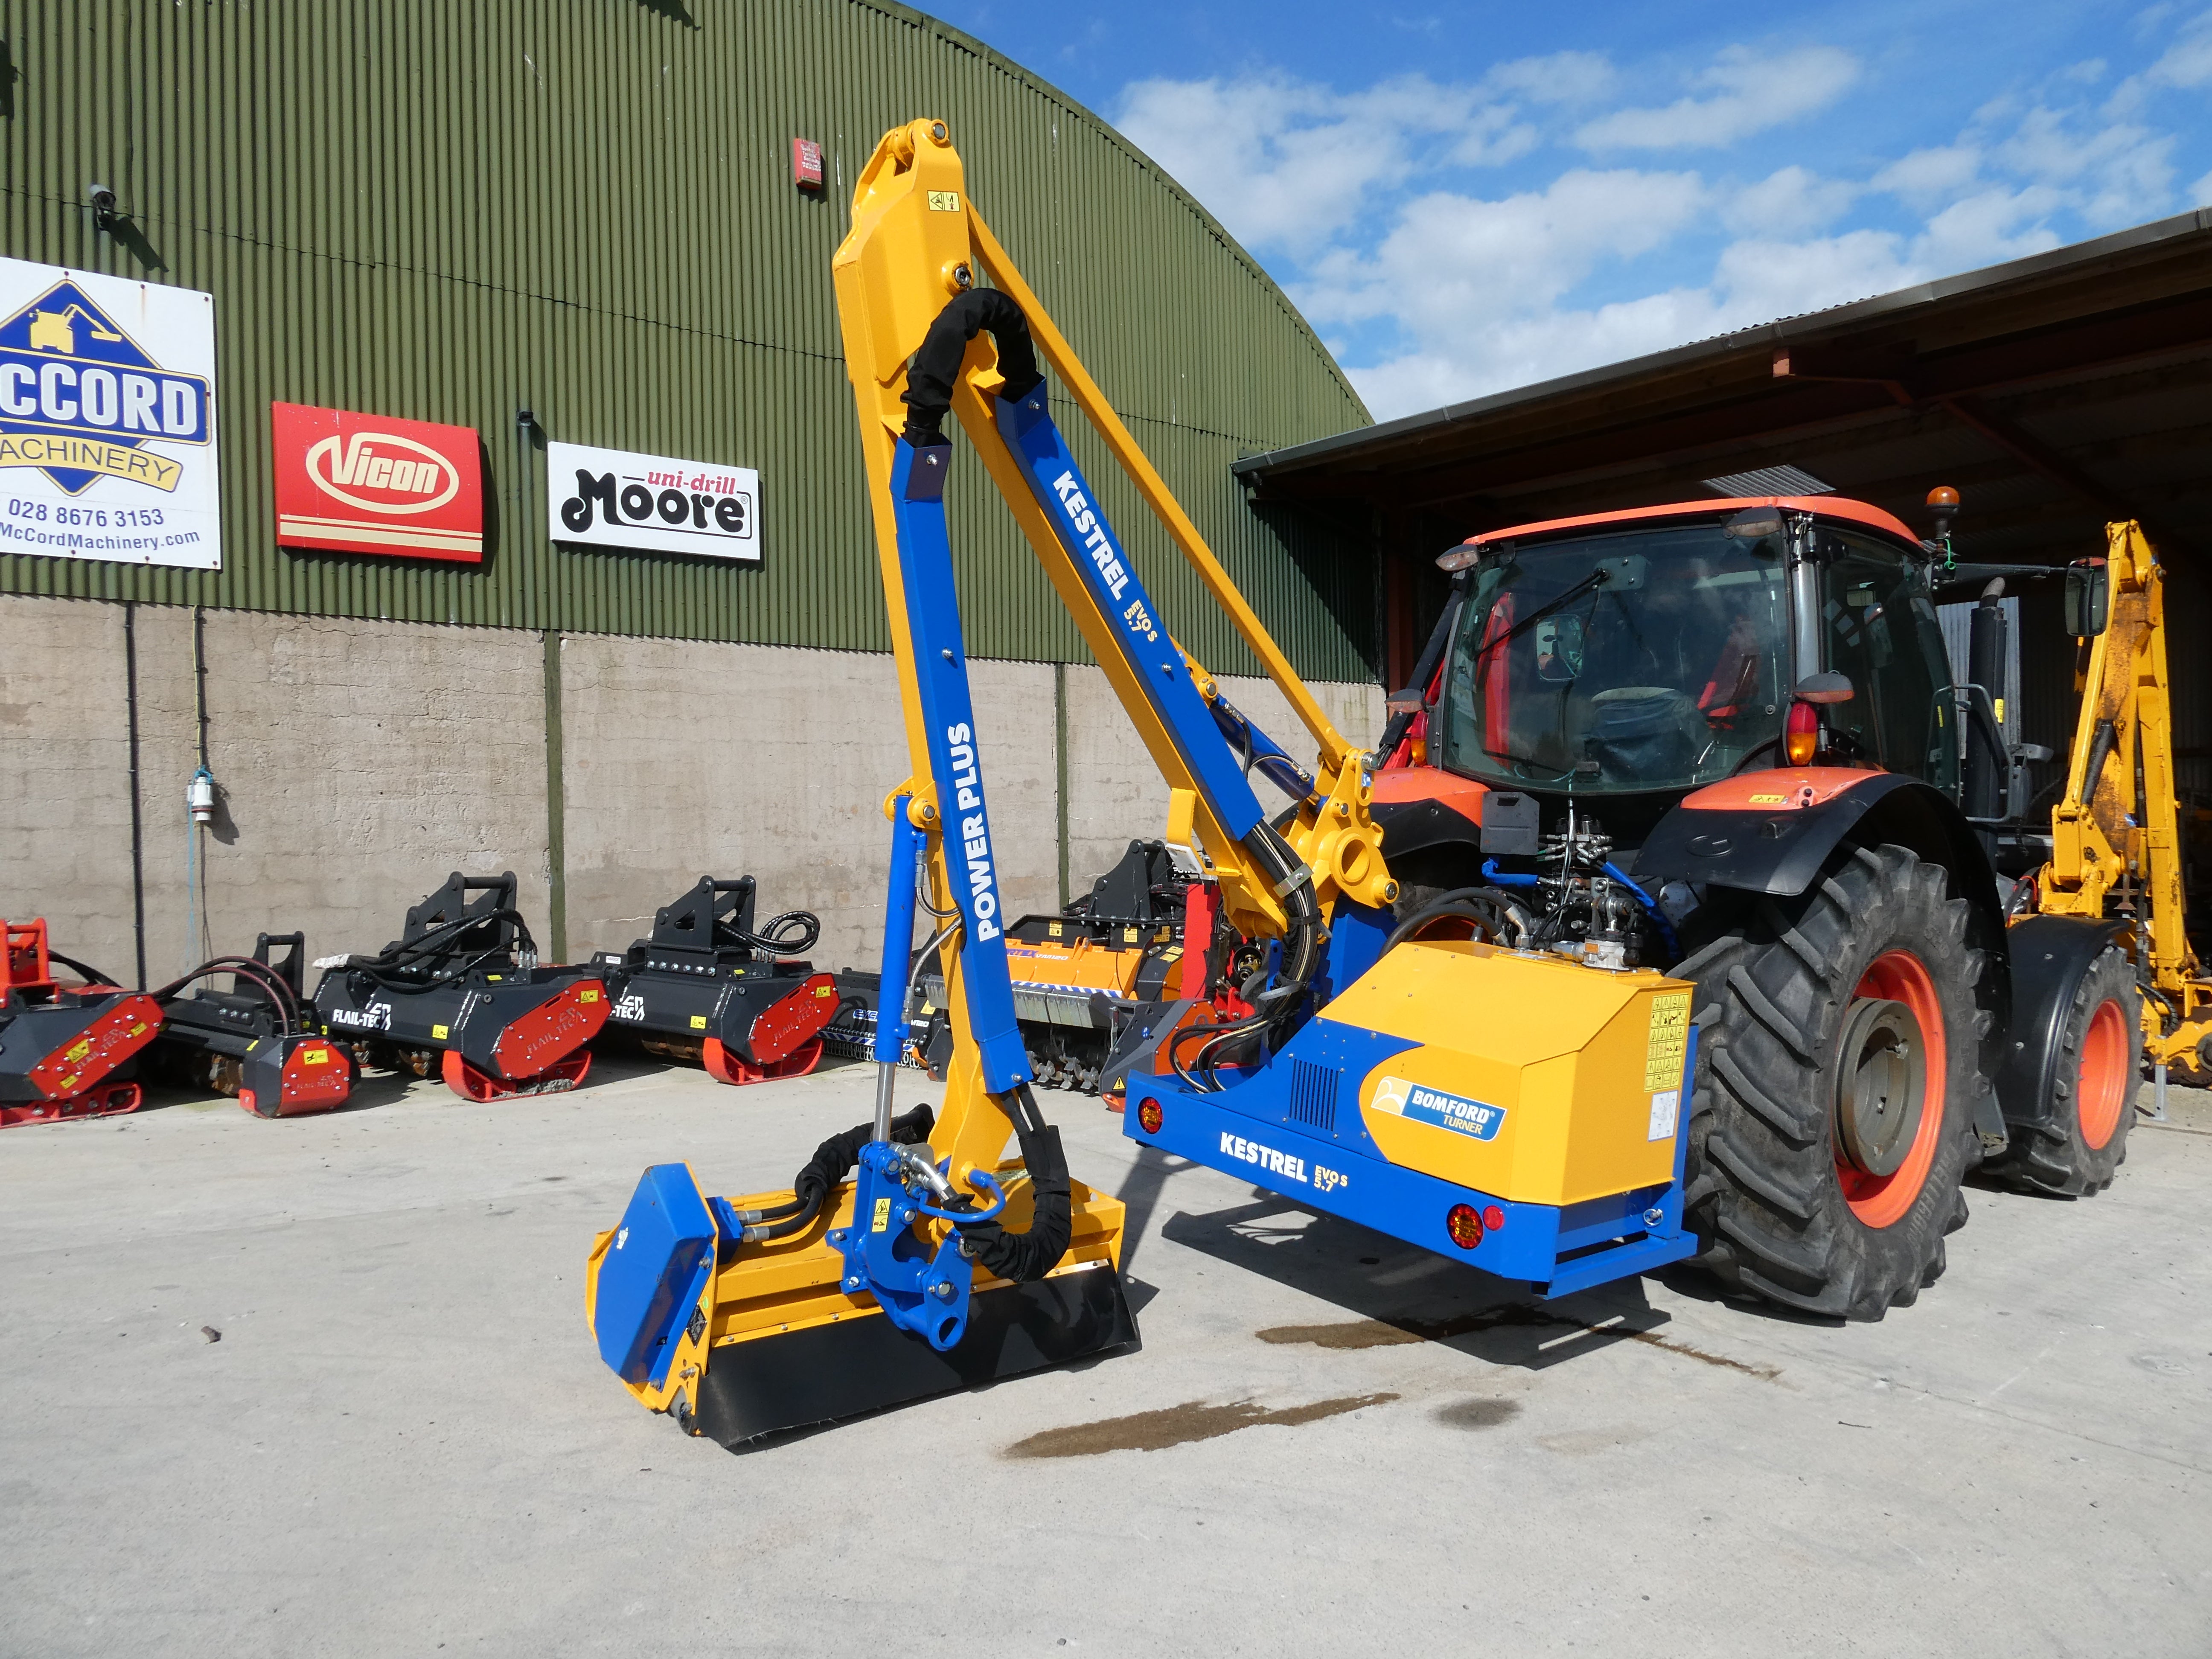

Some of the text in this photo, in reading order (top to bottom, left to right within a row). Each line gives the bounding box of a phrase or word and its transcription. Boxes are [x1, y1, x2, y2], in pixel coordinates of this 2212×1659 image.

[0, 363, 197, 435] CCORD
[0, 439, 174, 481] ACHINERY
[332, 432, 439, 494] Vicon
[647, 471, 736, 495] uni-drill
[9, 499, 164, 527] 028 8676 3153
[561, 469, 745, 533] Moore
[1053, 470, 1129, 601] KESTREL
[1124, 608, 1142, 632] 5.7
[1131, 599, 1158, 642] EVO S
[948, 722, 1000, 942] POWER PLUS
[1006, 948, 1039, 958] RTEX
[333, 1009, 381, 1028] FLAIL-TEC
[610, 1004, 634, 1019] -TEC
[853, 1009, 878, 1019] CYC
[1412, 1089, 1490, 1124] BOMFORD
[1444, 1114, 1483, 1135] TURNER
[1220, 1132, 1307, 1183] KESTREL
[1314, 1175, 1333, 1192] 5.7
[1315, 1165, 1348, 1187] EVO S
